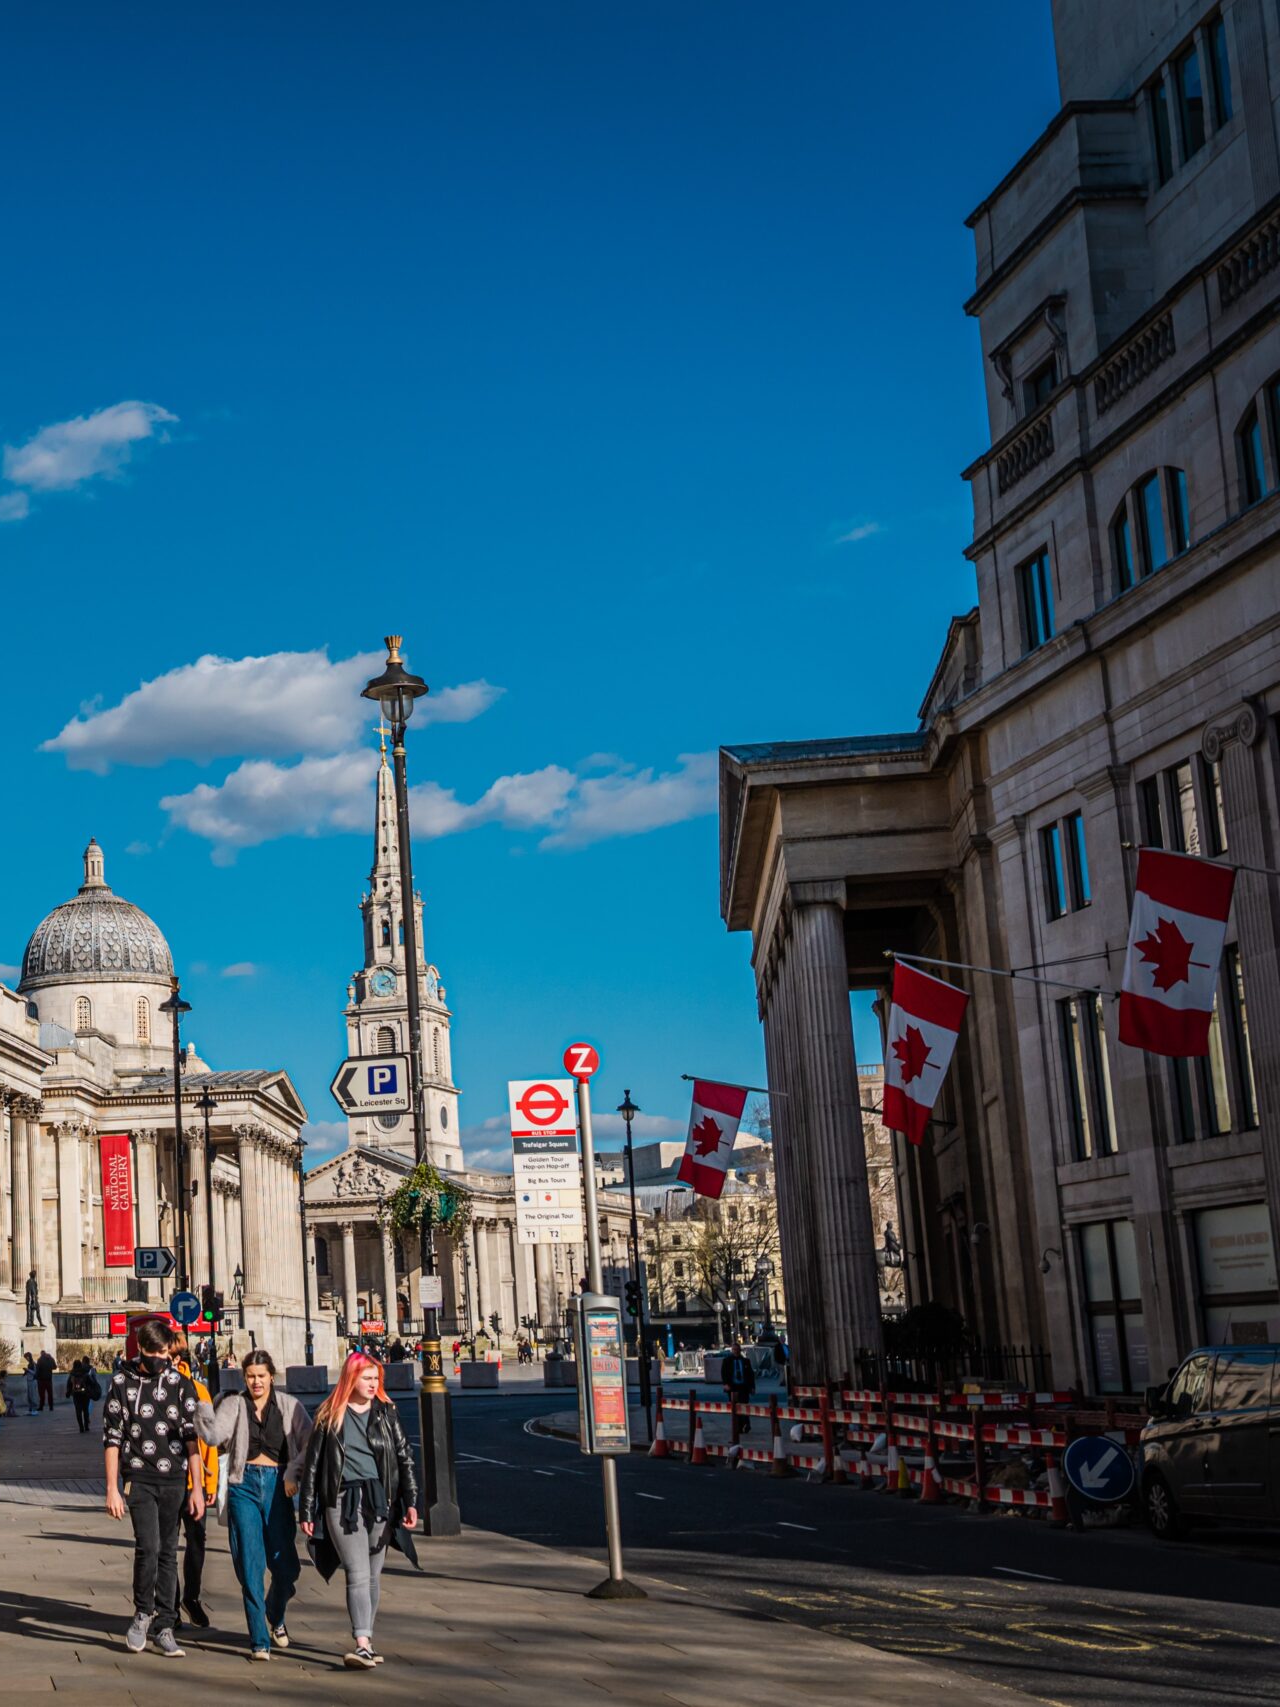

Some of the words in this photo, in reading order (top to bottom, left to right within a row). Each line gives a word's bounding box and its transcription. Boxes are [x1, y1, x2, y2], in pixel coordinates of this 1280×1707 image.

[571, 1048, 593, 1072] Z
[374, 1068, 391, 1093] P
[360, 1099, 393, 1107] Leicester
[109, 1154, 119, 1210] NATIONAL
[118, 1154, 129, 1210] GALLERY
[143, 1253, 154, 1267] P
